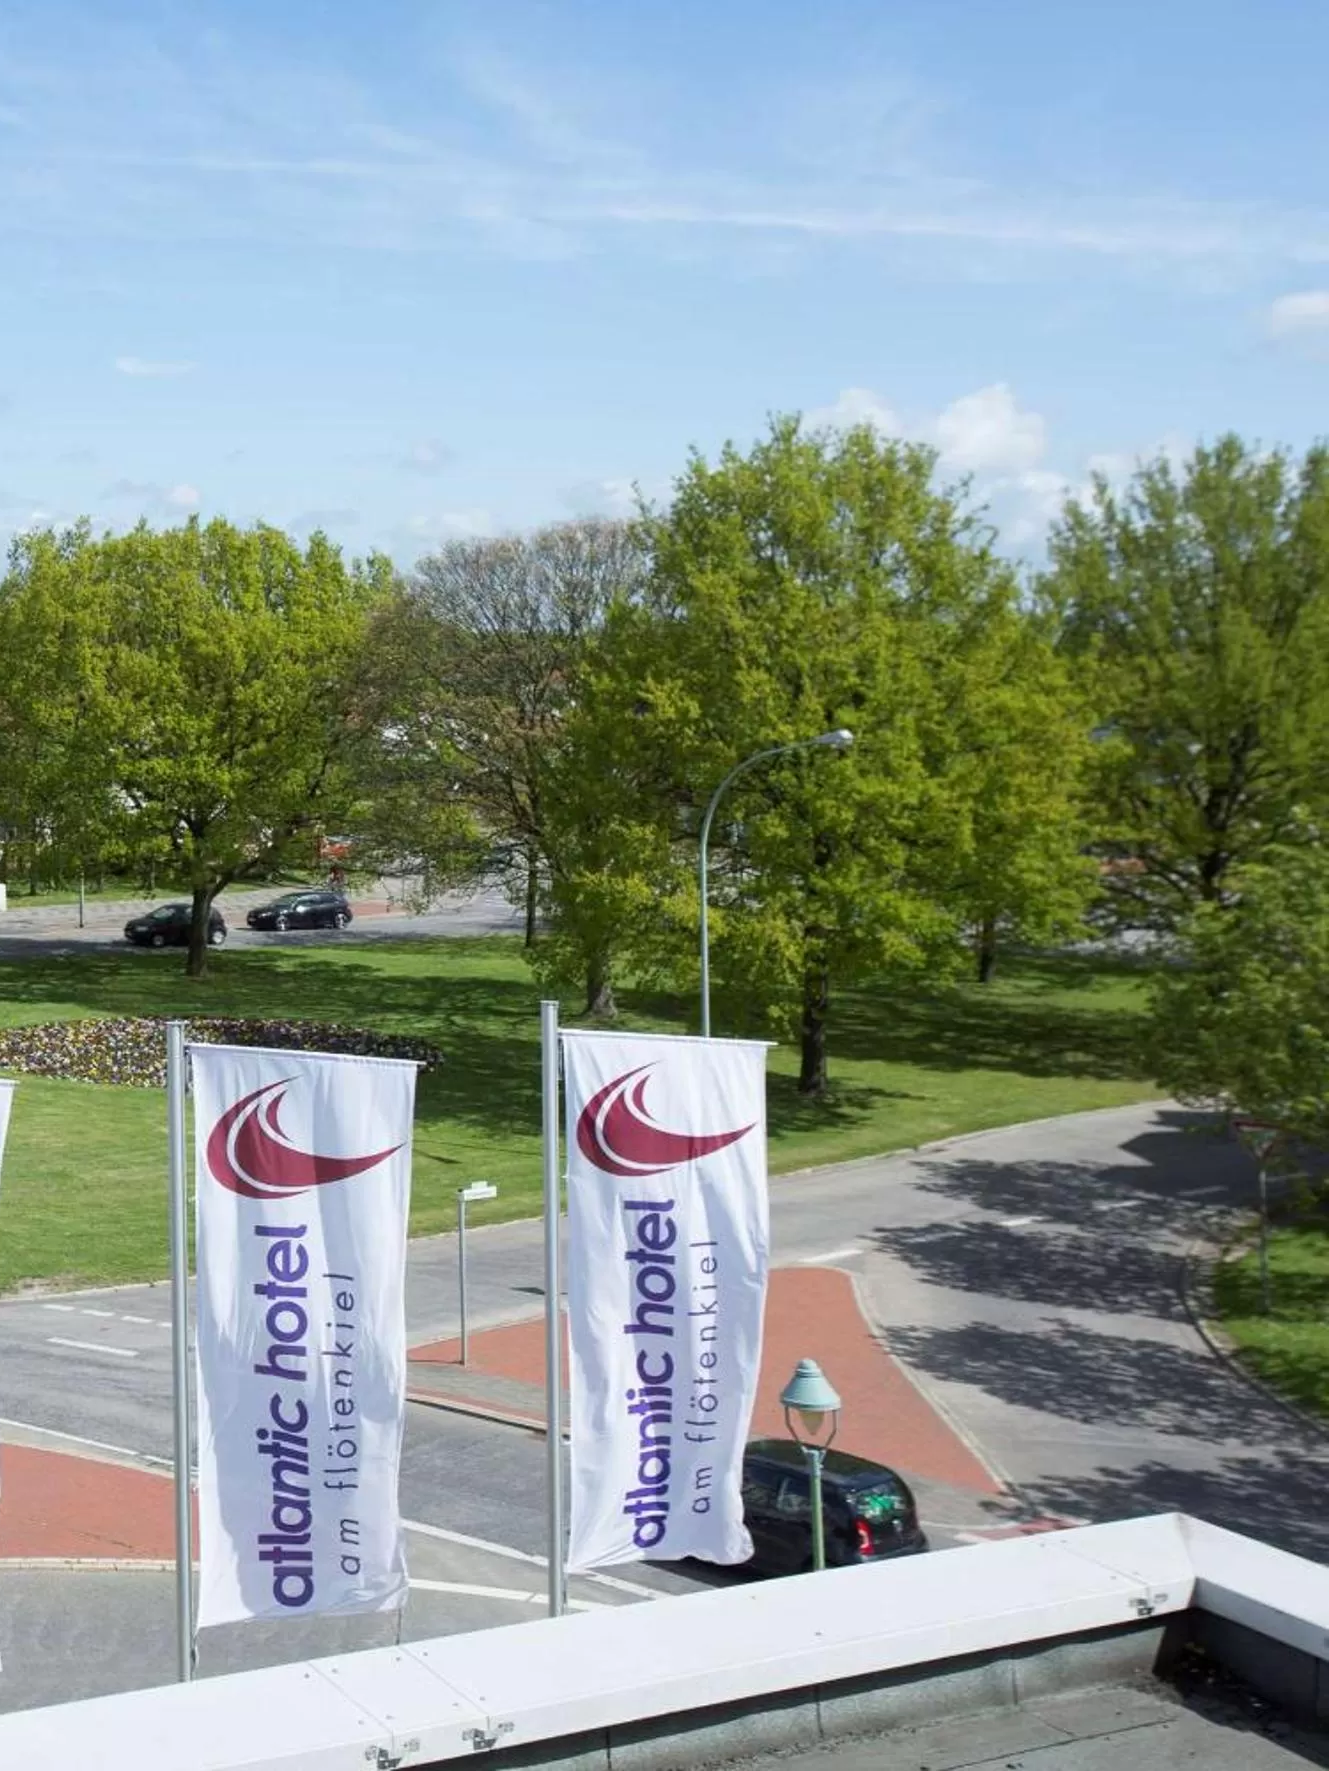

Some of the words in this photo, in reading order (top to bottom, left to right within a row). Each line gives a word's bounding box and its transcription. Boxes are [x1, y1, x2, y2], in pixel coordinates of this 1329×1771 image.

[253, 1223, 310, 1384] hotel
[623, 1195, 678, 1338] hotel
[683, 1239, 719, 1444] flötenkiel
[322, 1272, 359, 1491] flötenkiel
[622, 1348, 675, 1550] atlantic
[255, 1391, 314, 1608] atlantic
[339, 1518, 362, 1576] am
[691, 1465, 714, 1515] am
